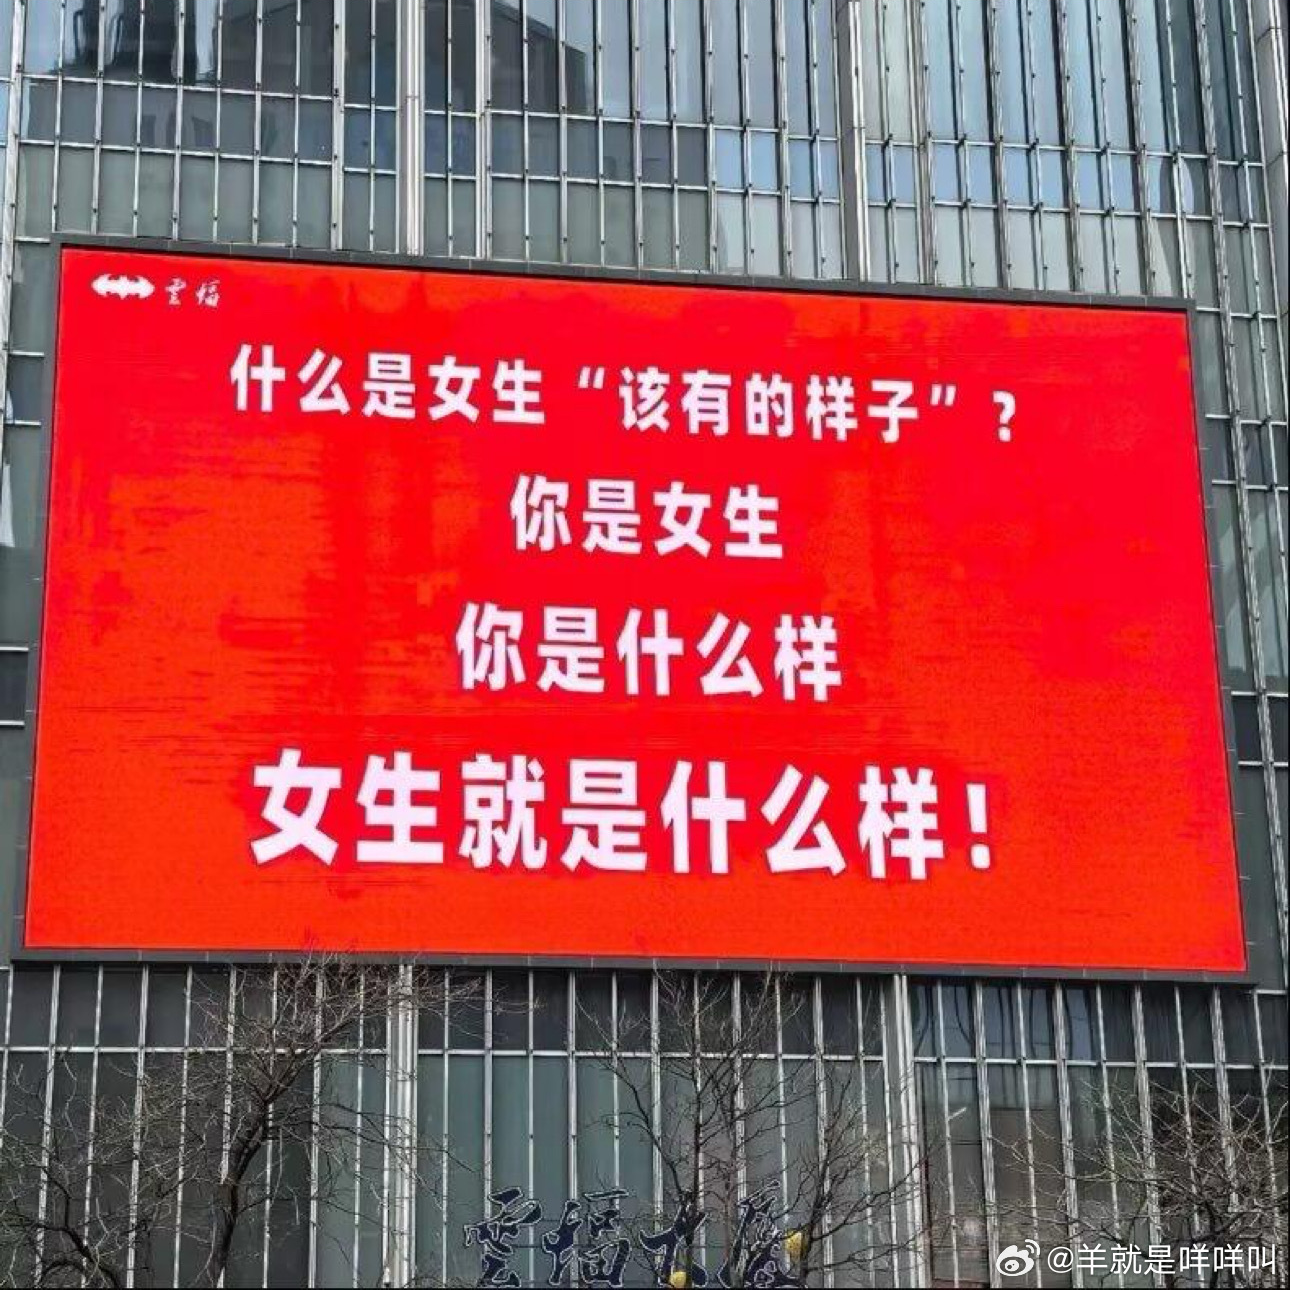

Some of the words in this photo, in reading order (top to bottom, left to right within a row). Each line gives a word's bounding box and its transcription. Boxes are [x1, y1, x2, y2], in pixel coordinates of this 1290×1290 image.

[229, 343, 1016, 443] 什么是女生“该有的样子”？
[509, 474, 784, 560] 你是女生
[455, 602, 842, 702] 你是什么样
[250, 747, 992, 881] 女生就是什么样！
